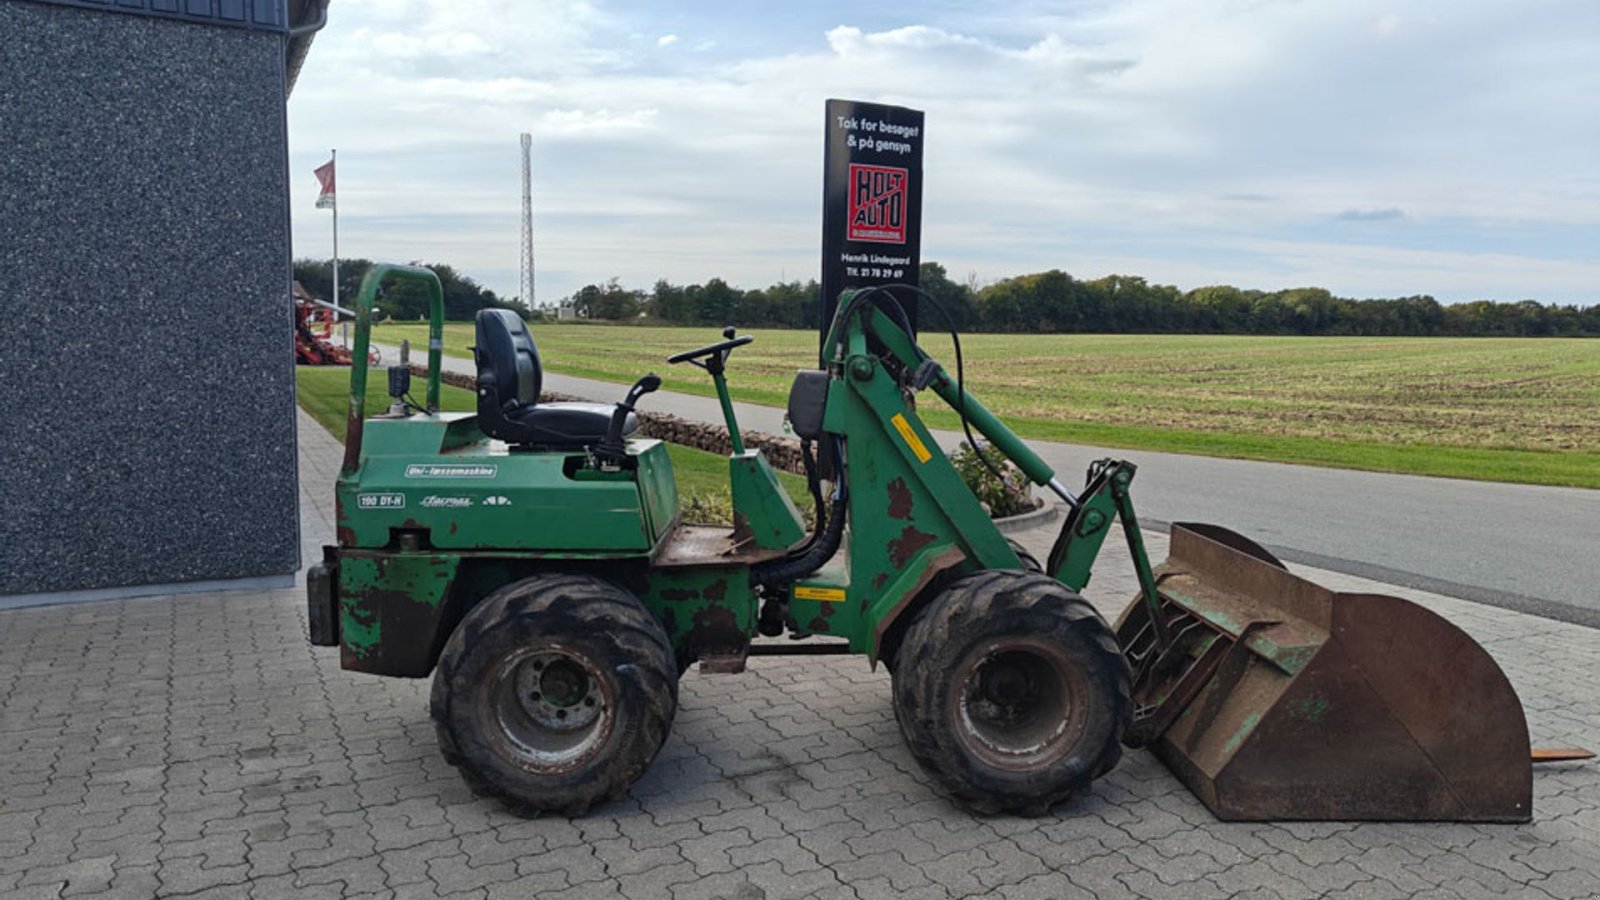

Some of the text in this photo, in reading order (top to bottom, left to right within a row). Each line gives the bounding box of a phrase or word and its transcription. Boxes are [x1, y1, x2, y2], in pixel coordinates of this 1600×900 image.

[838, 116, 919, 138] Tak for besøget
[847, 134, 911, 155] & på gensyn
[856, 169, 903, 208] HOLT
[853, 191, 902, 228] AUTO
[841, 253, 869, 263] Henrik
[361, 496, 377, 506] 190
